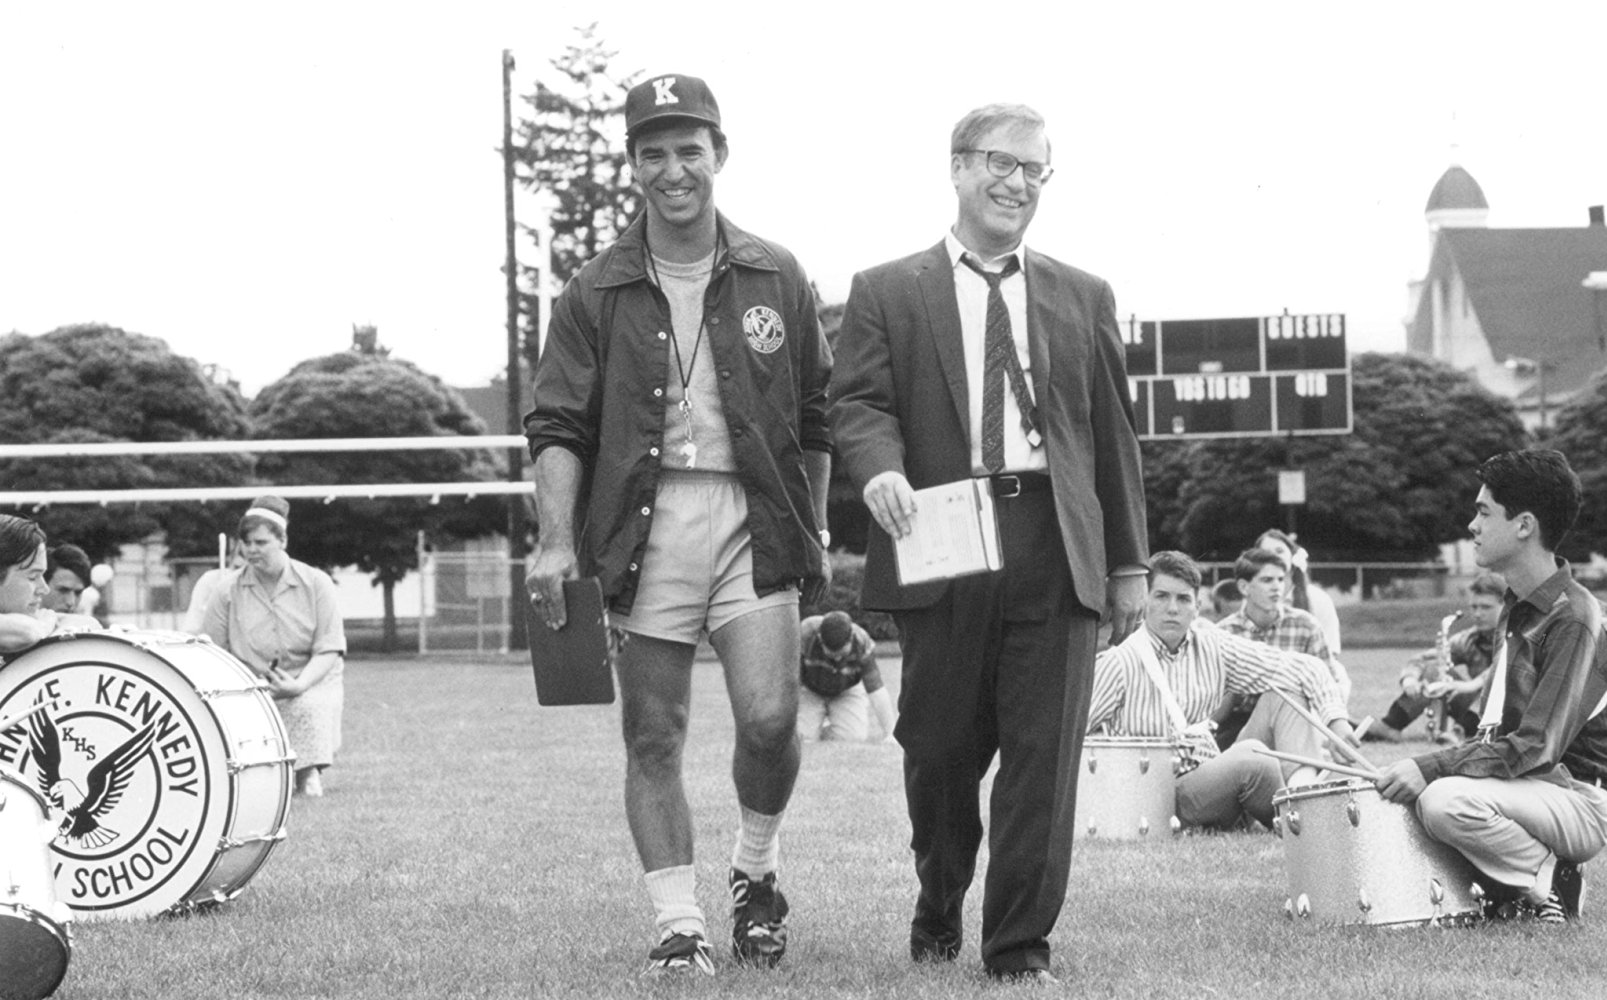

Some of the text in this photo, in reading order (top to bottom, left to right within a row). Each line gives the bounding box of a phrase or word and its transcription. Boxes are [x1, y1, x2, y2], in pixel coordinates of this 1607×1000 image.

[652, 77, 679, 106] K
[61, 727, 97, 761] KHS
[95, 673, 198, 797] KENNEDY
[71, 826, 190, 899] SCHOOL
